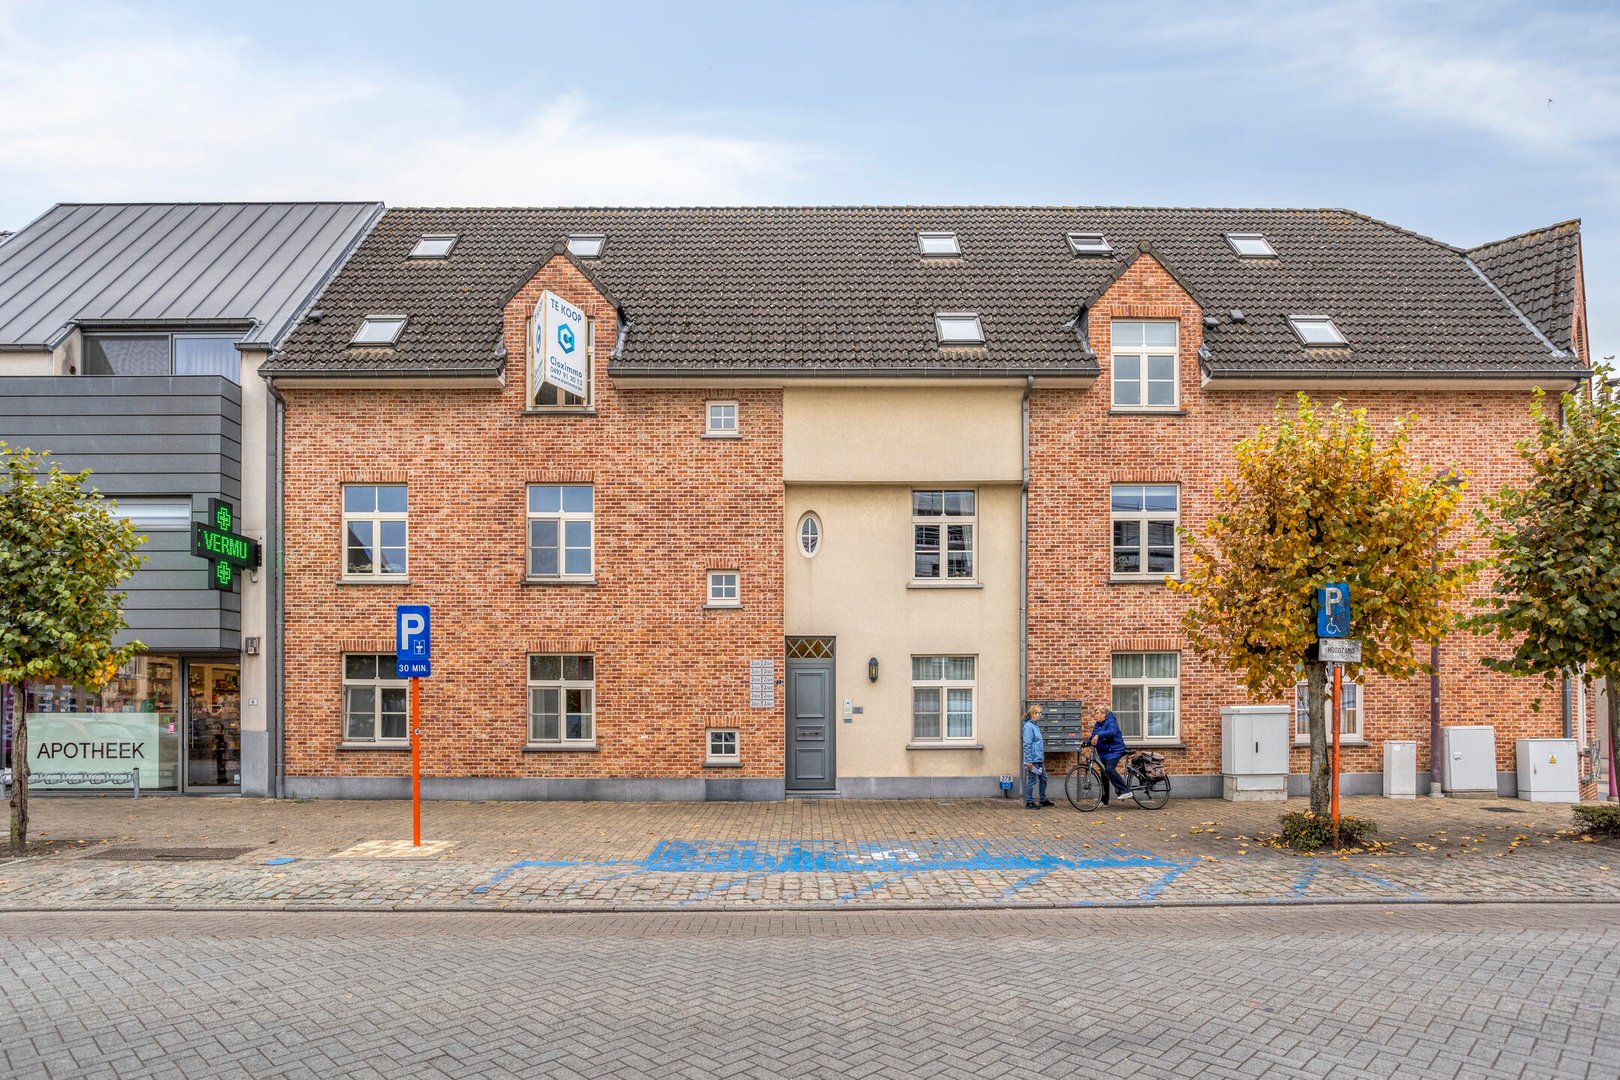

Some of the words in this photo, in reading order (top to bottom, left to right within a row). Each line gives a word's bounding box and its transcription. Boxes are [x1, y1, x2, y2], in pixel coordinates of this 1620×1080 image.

[551, 298, 559, 311] TE
[561, 304, 582, 324] KOOP
[203, 530, 247, 560] VERMU
[1325, 587, 1343, 616] P
[401, 613, 425, 650] P
[398, 664, 409, 672] 30
[412, 664, 428, 672] MIN.
[36, 742, 145, 759] APOTHEEK
